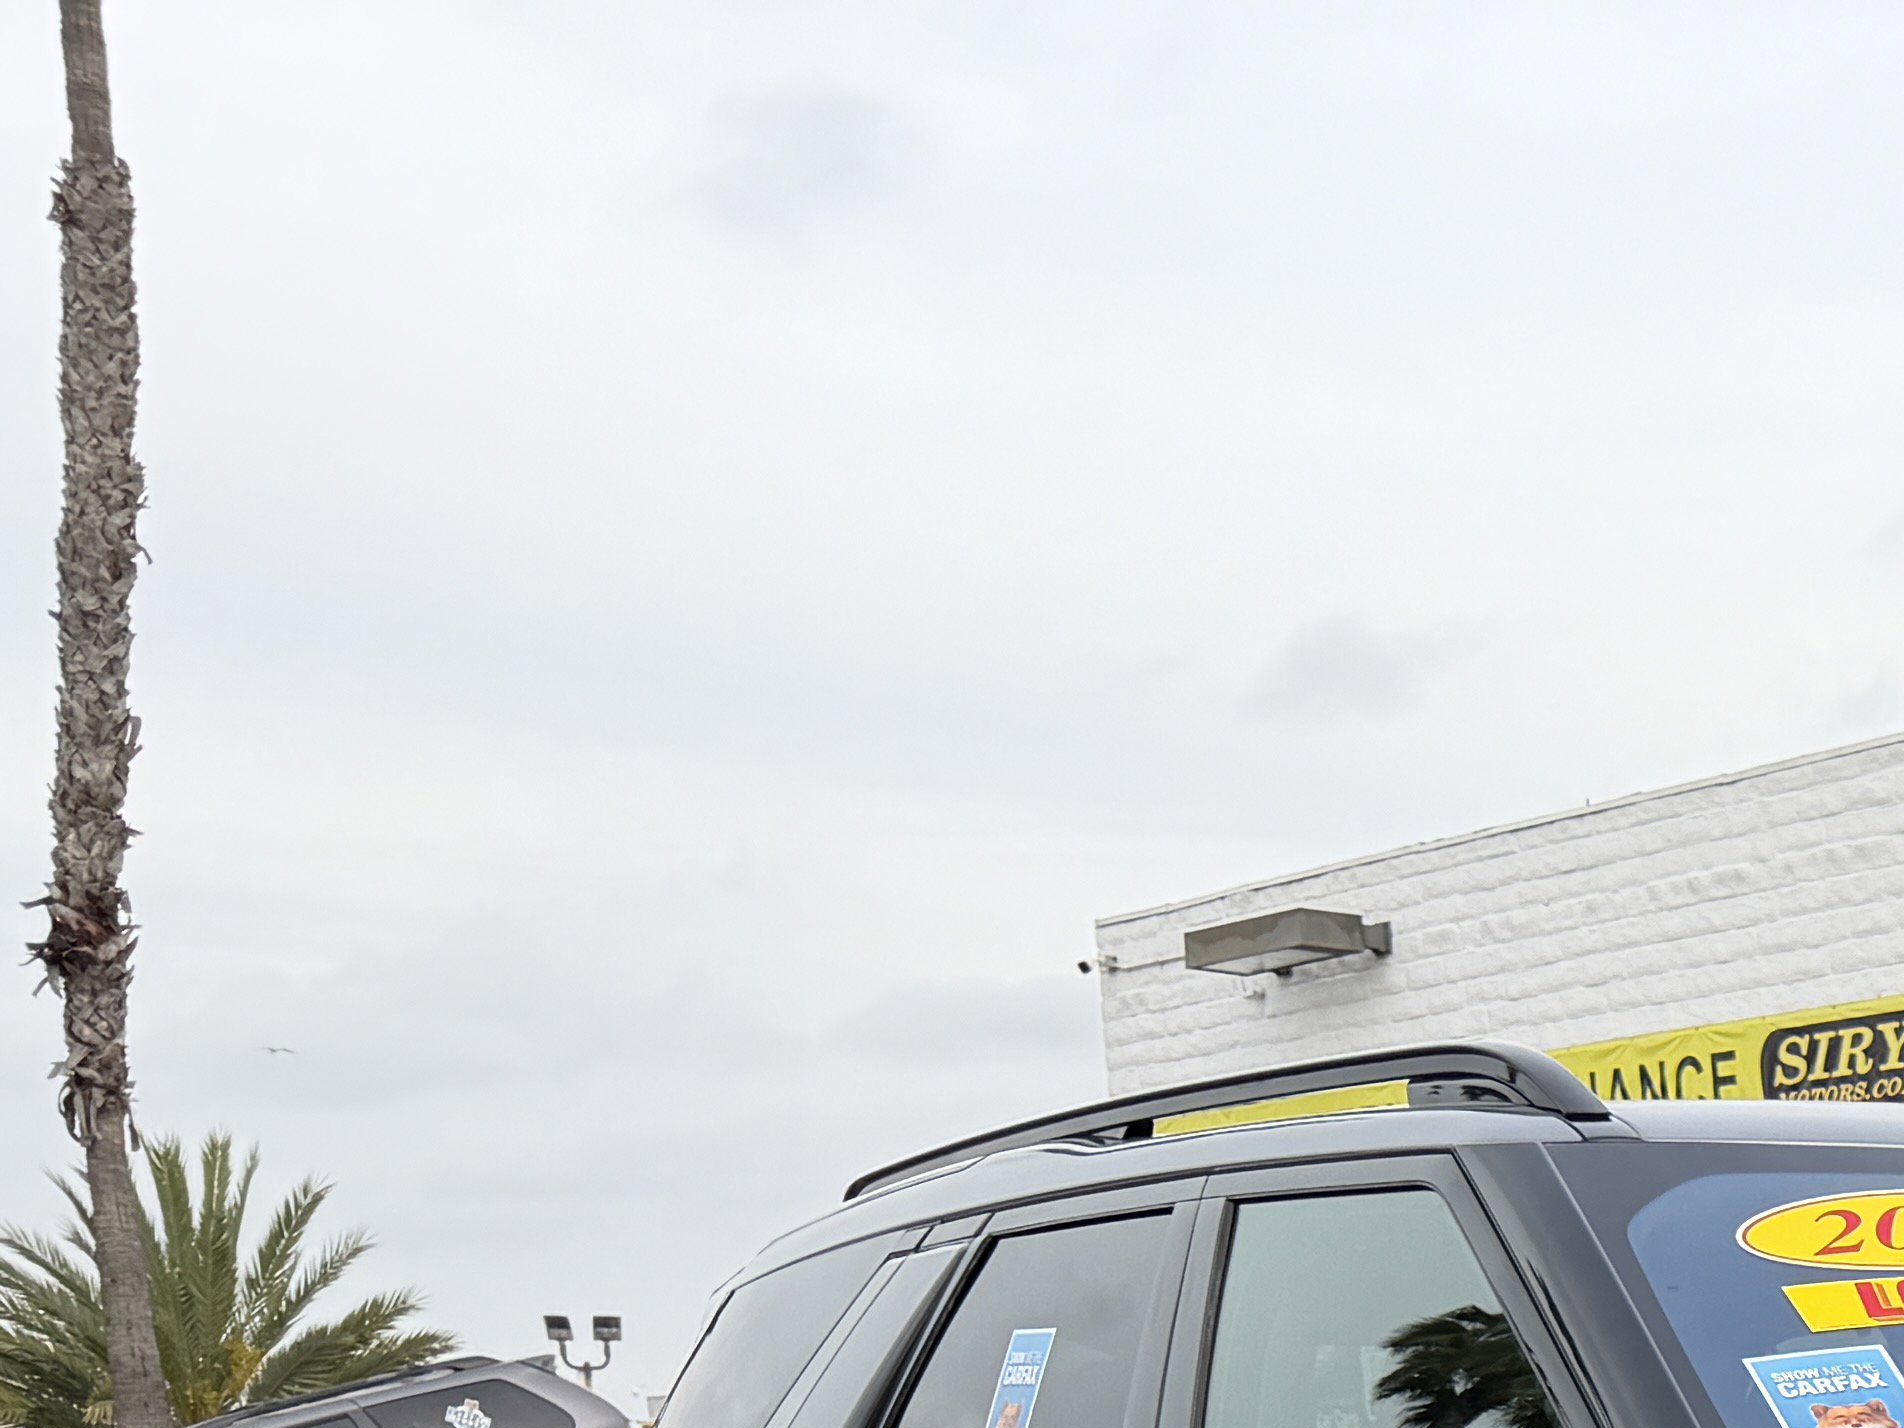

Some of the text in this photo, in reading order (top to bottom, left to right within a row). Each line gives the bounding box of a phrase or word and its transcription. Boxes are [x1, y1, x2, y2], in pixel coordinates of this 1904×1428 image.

[1770, 1362, 1879, 1383] SHOW ME THE
[1776, 1371, 1888, 1398] CARFAX
